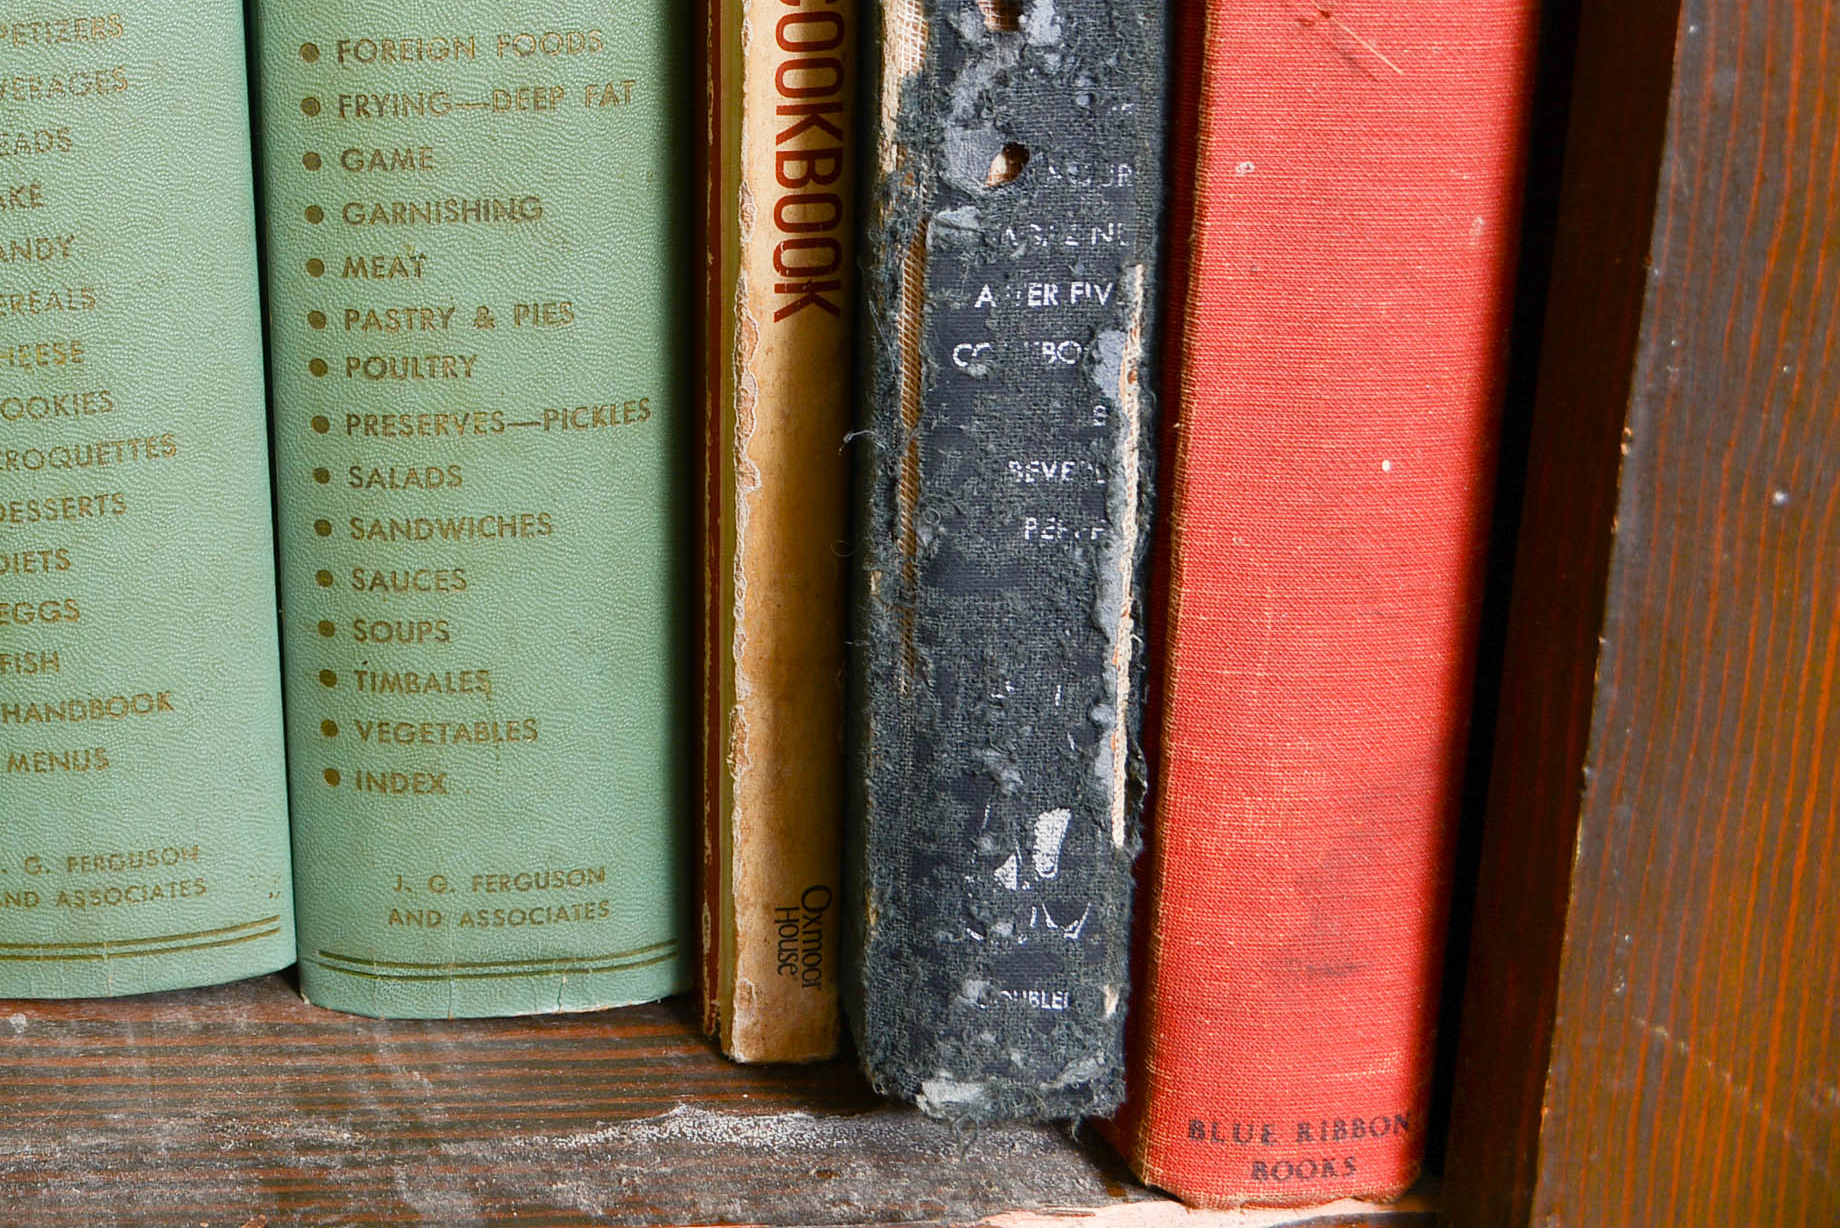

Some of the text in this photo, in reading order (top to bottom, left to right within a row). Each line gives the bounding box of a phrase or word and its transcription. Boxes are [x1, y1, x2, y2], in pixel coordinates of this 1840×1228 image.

[337, 28, 603, 65] FOREIGN FOODS
[585, 80, 635, 108] FAT
[341, 147, 433, 173] GAME
[342, 196, 542, 225] GARNISHING
[341, 255, 426, 280] MEAT
[344, 301, 575, 332] PASTRY & PIES
[345, 354, 477, 381] POULTRY
[348, 465, 463, 490] SALADS
[349, 513, 552, 542] SANDWICHES
[352, 568, 467, 593] SAUCES
[353, 620, 450, 644] SOUPS
[0, 651, 60, 674] FISH
[354, 669, 491, 694] TIMBALES
[1, 691, 175, 725] HANDBOOK
[354, 718, 539, 745] VEGETABLES
[6, 748, 110, 773] MENUS
[356, 770, 448, 794] INDEX
[24, 856, 50, 875] G.
[66, 845, 201, 874] FERGUSON
[392, 866, 606, 893] J. G. FERGUSON
[55, 878, 207, 909] ASSOCIATES
[388, 900, 610, 928] AND ASSOCIATES
[774, 906, 800, 976] House
[801, 885, 833, 990] Oxmoor
[1188, 1112, 1410, 1146] BLUE RIBBON
[1251, 1156, 1357, 1182] BOOKS
